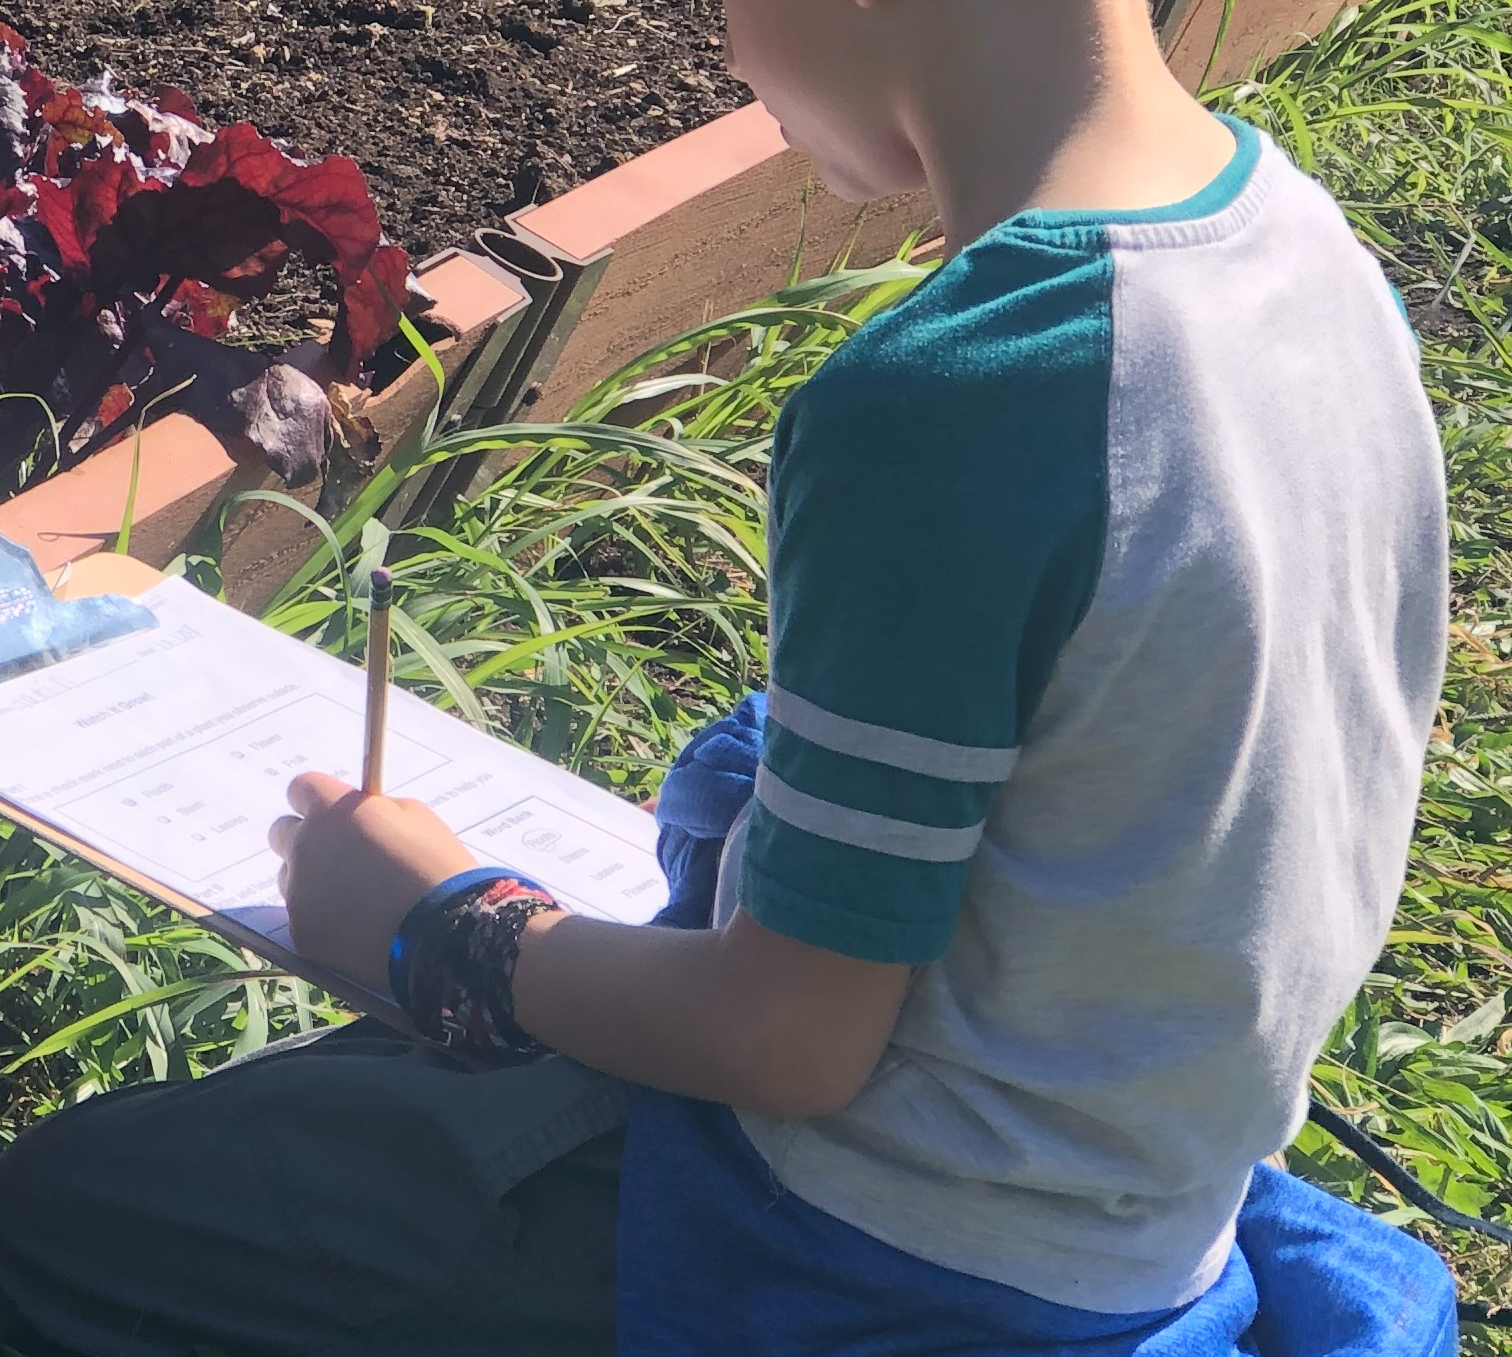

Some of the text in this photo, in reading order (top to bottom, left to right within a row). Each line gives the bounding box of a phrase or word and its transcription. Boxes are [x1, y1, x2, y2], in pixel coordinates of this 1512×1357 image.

[453, 781, 477, 793] help
[474, 772, 493, 785] you
[481, 810, 534, 837] Word Bank
